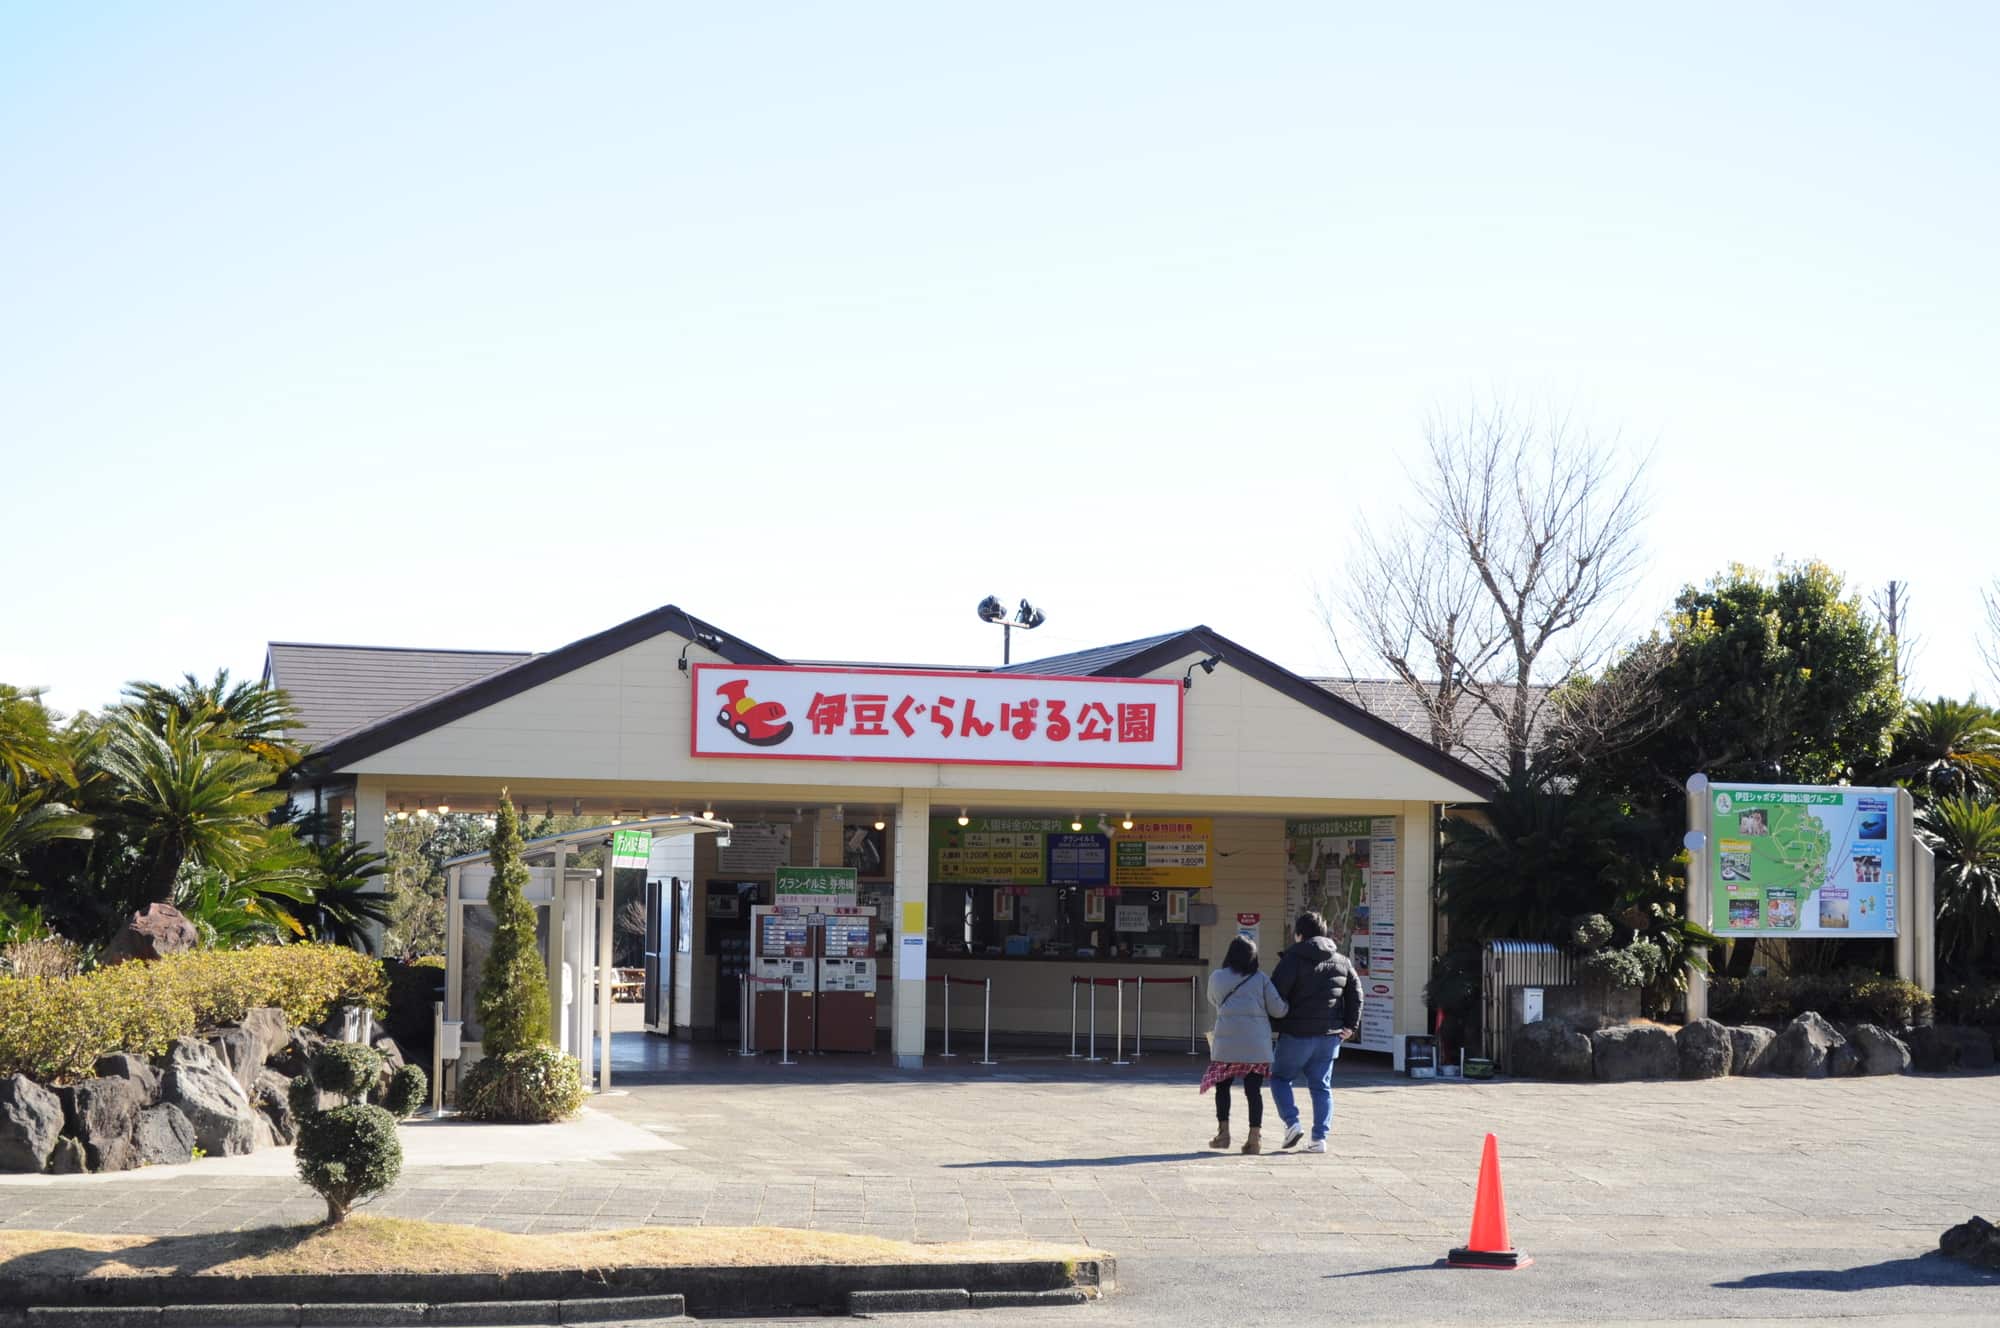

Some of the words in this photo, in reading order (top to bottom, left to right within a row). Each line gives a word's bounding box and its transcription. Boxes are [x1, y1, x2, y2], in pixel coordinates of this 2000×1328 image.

[805, 691, 1157, 743] 伊豆ぐらんぱる公園
[1735, 791, 1837, 804] 伊豆シャボテン動物公園グループ
[981, 818, 1062, 832] 入園料金のご案内
[778, 878, 828, 890] グランイルミ
[1058, 889, 1067, 900] 2
[1152, 890, 1161, 902] 3
